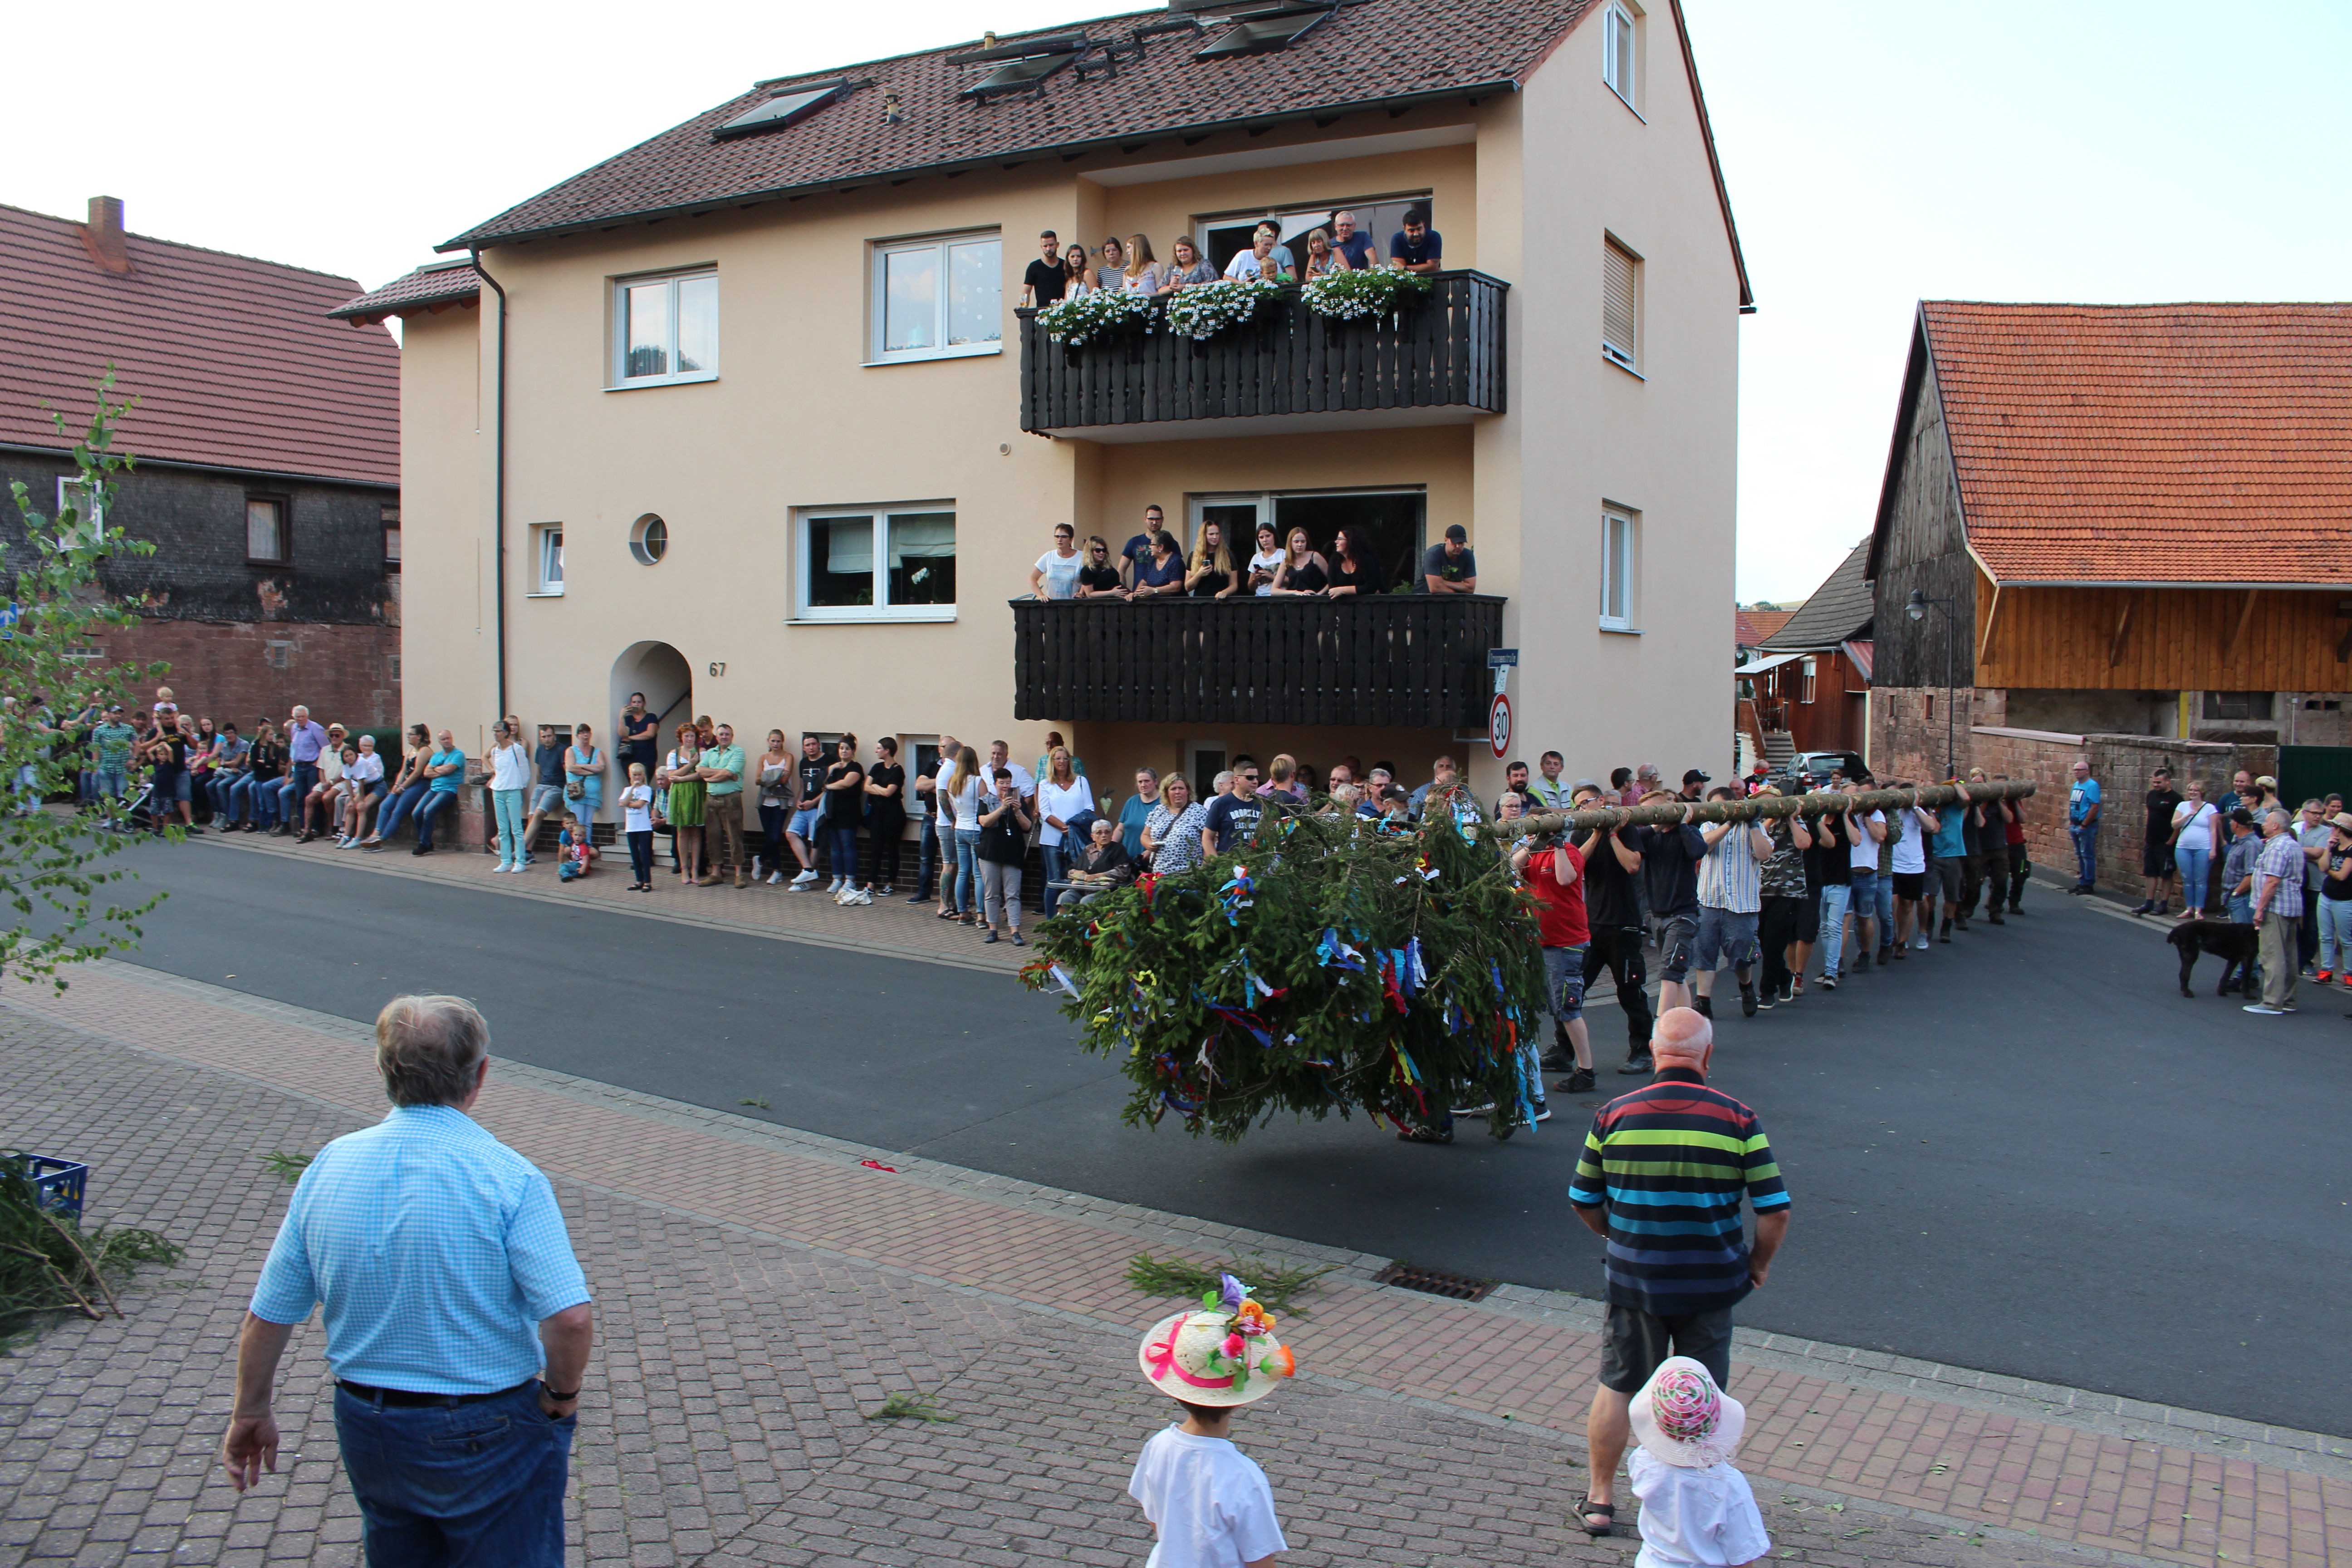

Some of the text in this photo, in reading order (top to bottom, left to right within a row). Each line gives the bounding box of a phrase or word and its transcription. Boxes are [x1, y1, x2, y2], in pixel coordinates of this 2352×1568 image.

[710, 662, 726, 676] 67
[1495, 711, 1507, 740] 30
[1230, 808, 1260, 819] BROOKLY
